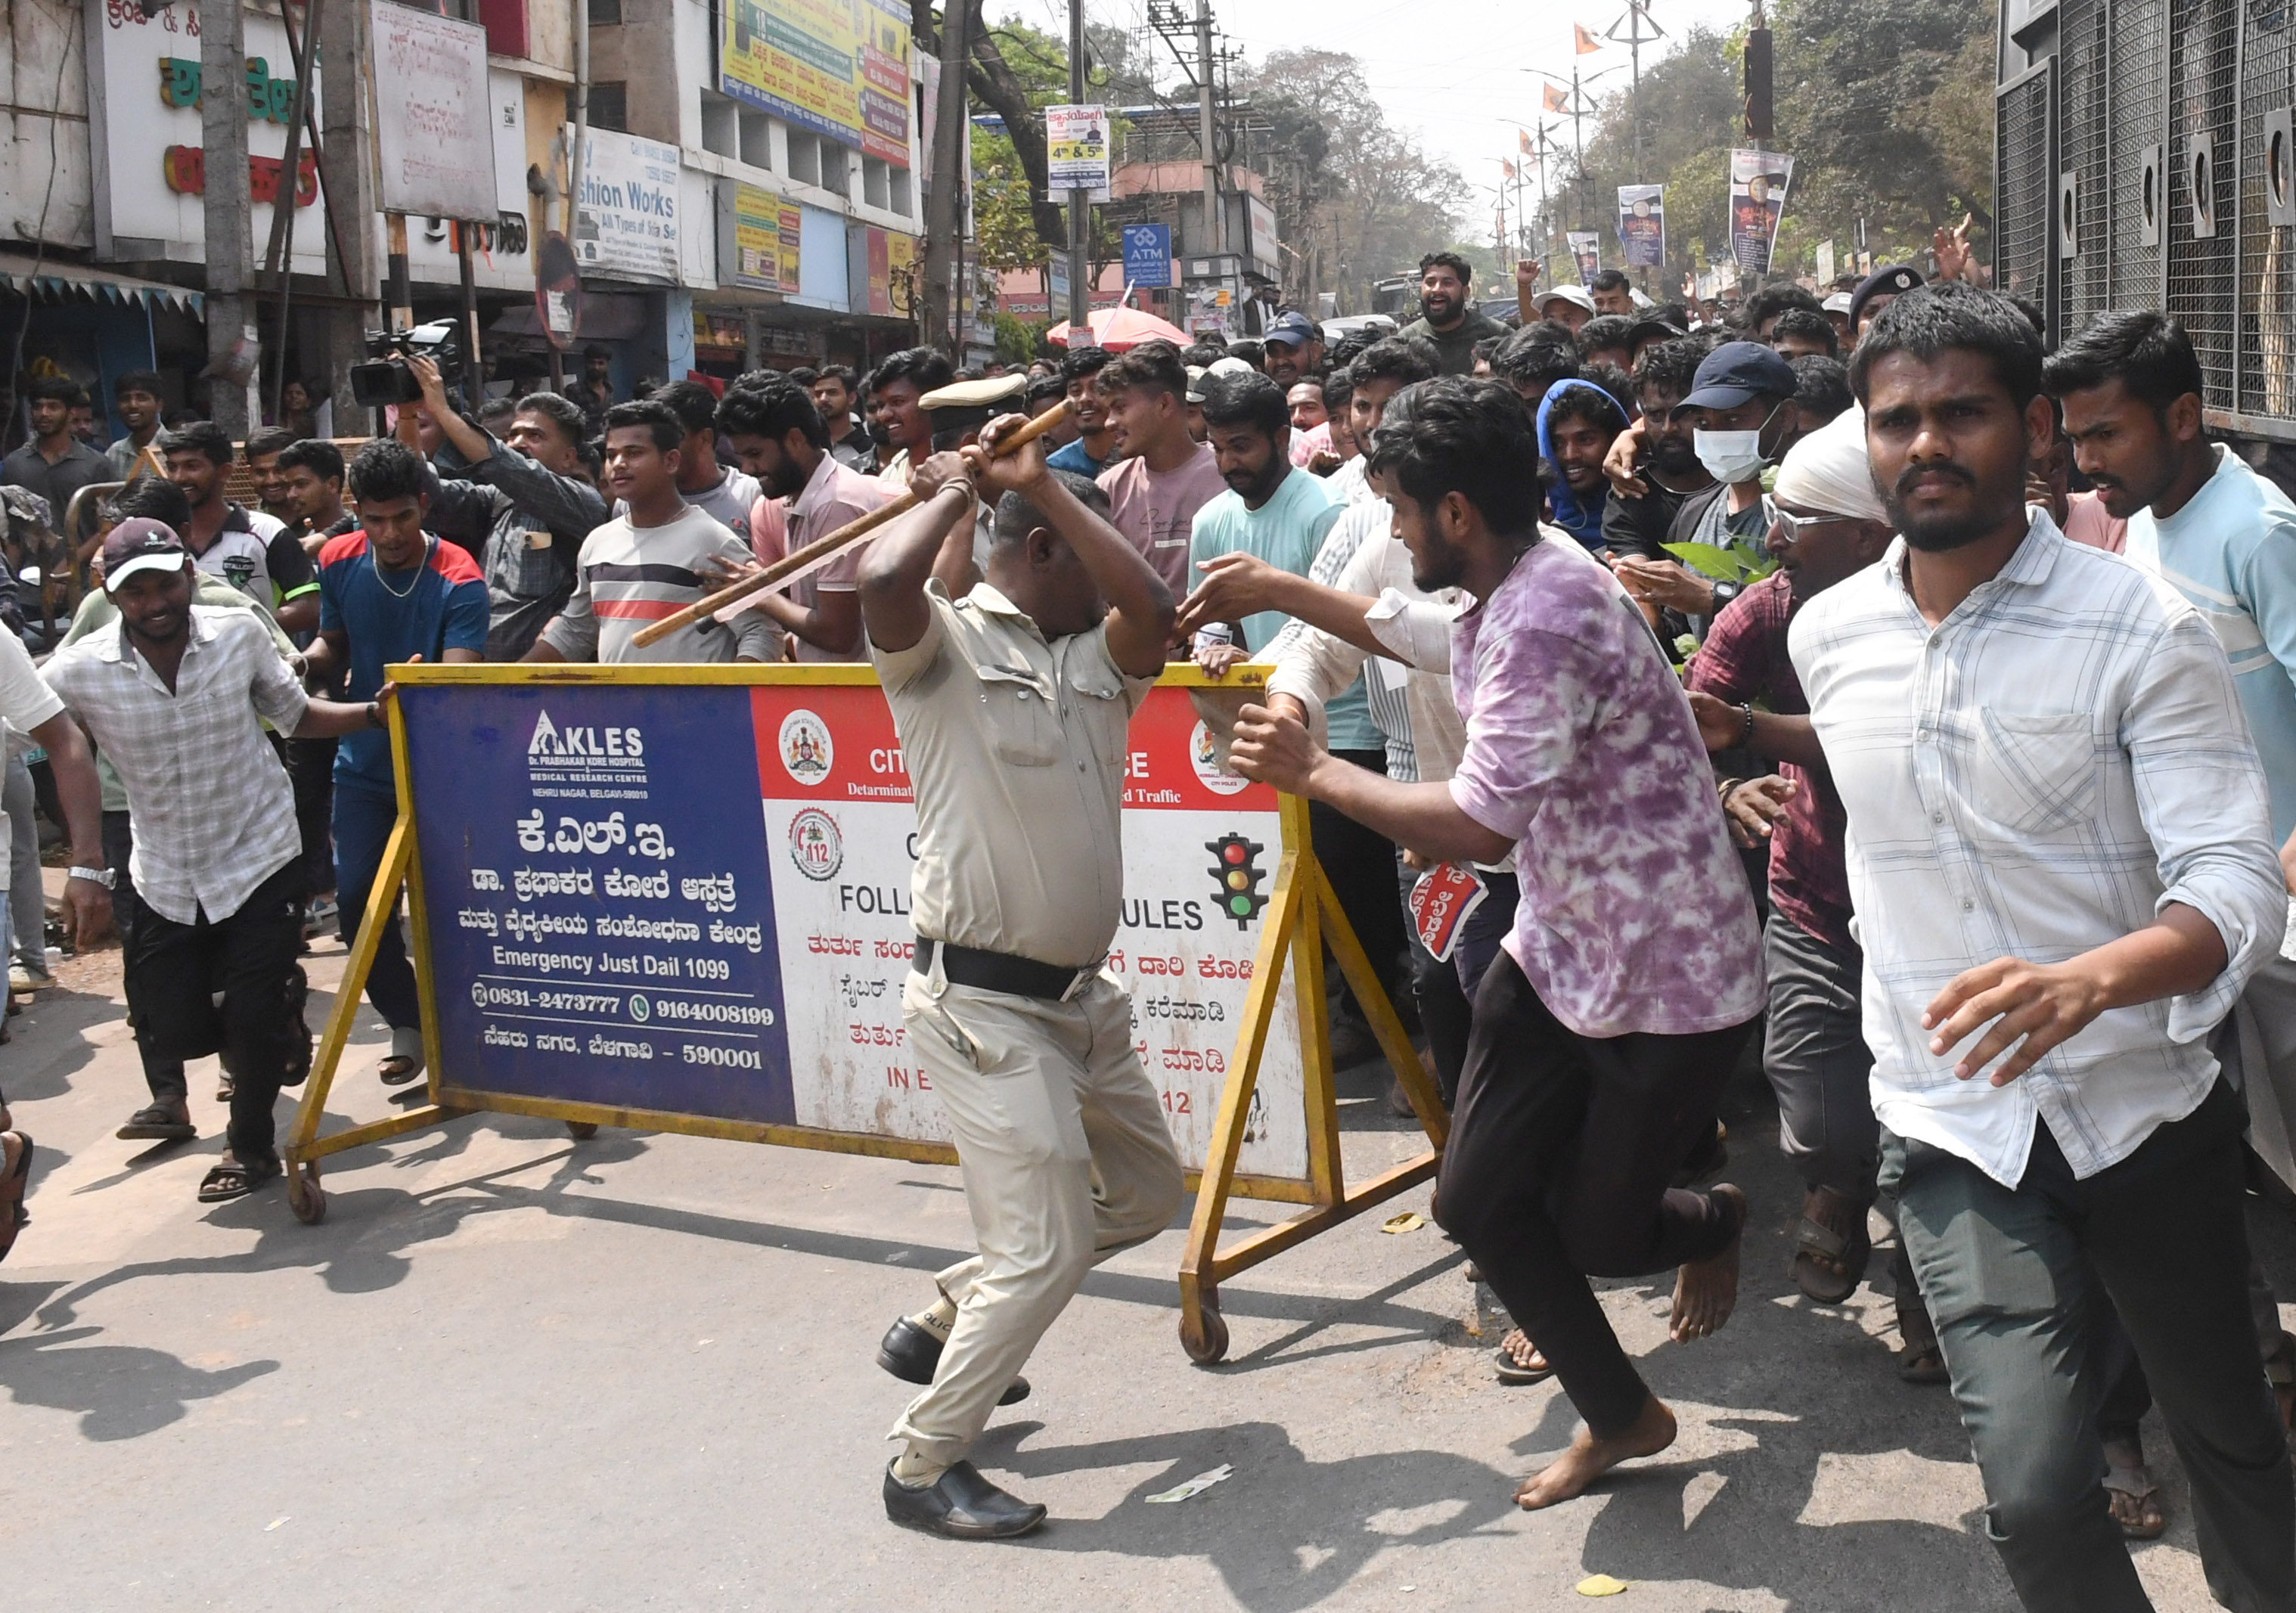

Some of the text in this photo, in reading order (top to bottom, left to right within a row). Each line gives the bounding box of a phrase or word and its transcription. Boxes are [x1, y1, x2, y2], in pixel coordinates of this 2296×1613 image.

[1053, 146, 1103, 158] 4th & 5th
[627, 181, 674, 219] Works
[1131, 248, 1163, 260] ATM
[529, 756, 645, 767] Dr. PRABHAKAR KORE HOSPITAL
[570, 774, 613, 782] RESEARCH
[615, 774, 647, 783] CENTRE
[532, 788, 558, 797] NEHRU
[560, 789, 589, 799] NAGAR,
[1135, 788, 1181, 804] Traffic
[807, 842, 828, 862] 112
[471, 864, 737, 913] ಡಾ. ಪ್ರಭಾಕರ ಕೋರೆ ಆಸ್ಪತ್ರೆ
[840, 885, 913, 916] FOLL
[1119, 898, 1203, 931] ULES
[458, 907, 762, 953] ಮತ್ತು ವೈದ್ಯಕೀಯ ಸಂಶೋಧನಾ ಕೇಂದ್ರ
[492, 945, 730, 981] Emergency Just Dail 1099
[1137, 956, 1185, 976] ದಾರಿ
[489, 986, 774, 1026] 0831-2473777 9164008199
[484, 1025, 529, 1048] ನೆಹರು
[536, 1031, 582, 1054] ನಗರ,
[588, 1034, 654, 1059] ಬೆಳಗಾವಿ
[682, 1044, 763, 1070] 590001
[1162, 1044, 1226, 1073] ಮಾಡಿ
[886, 1066, 910, 1089] IN
